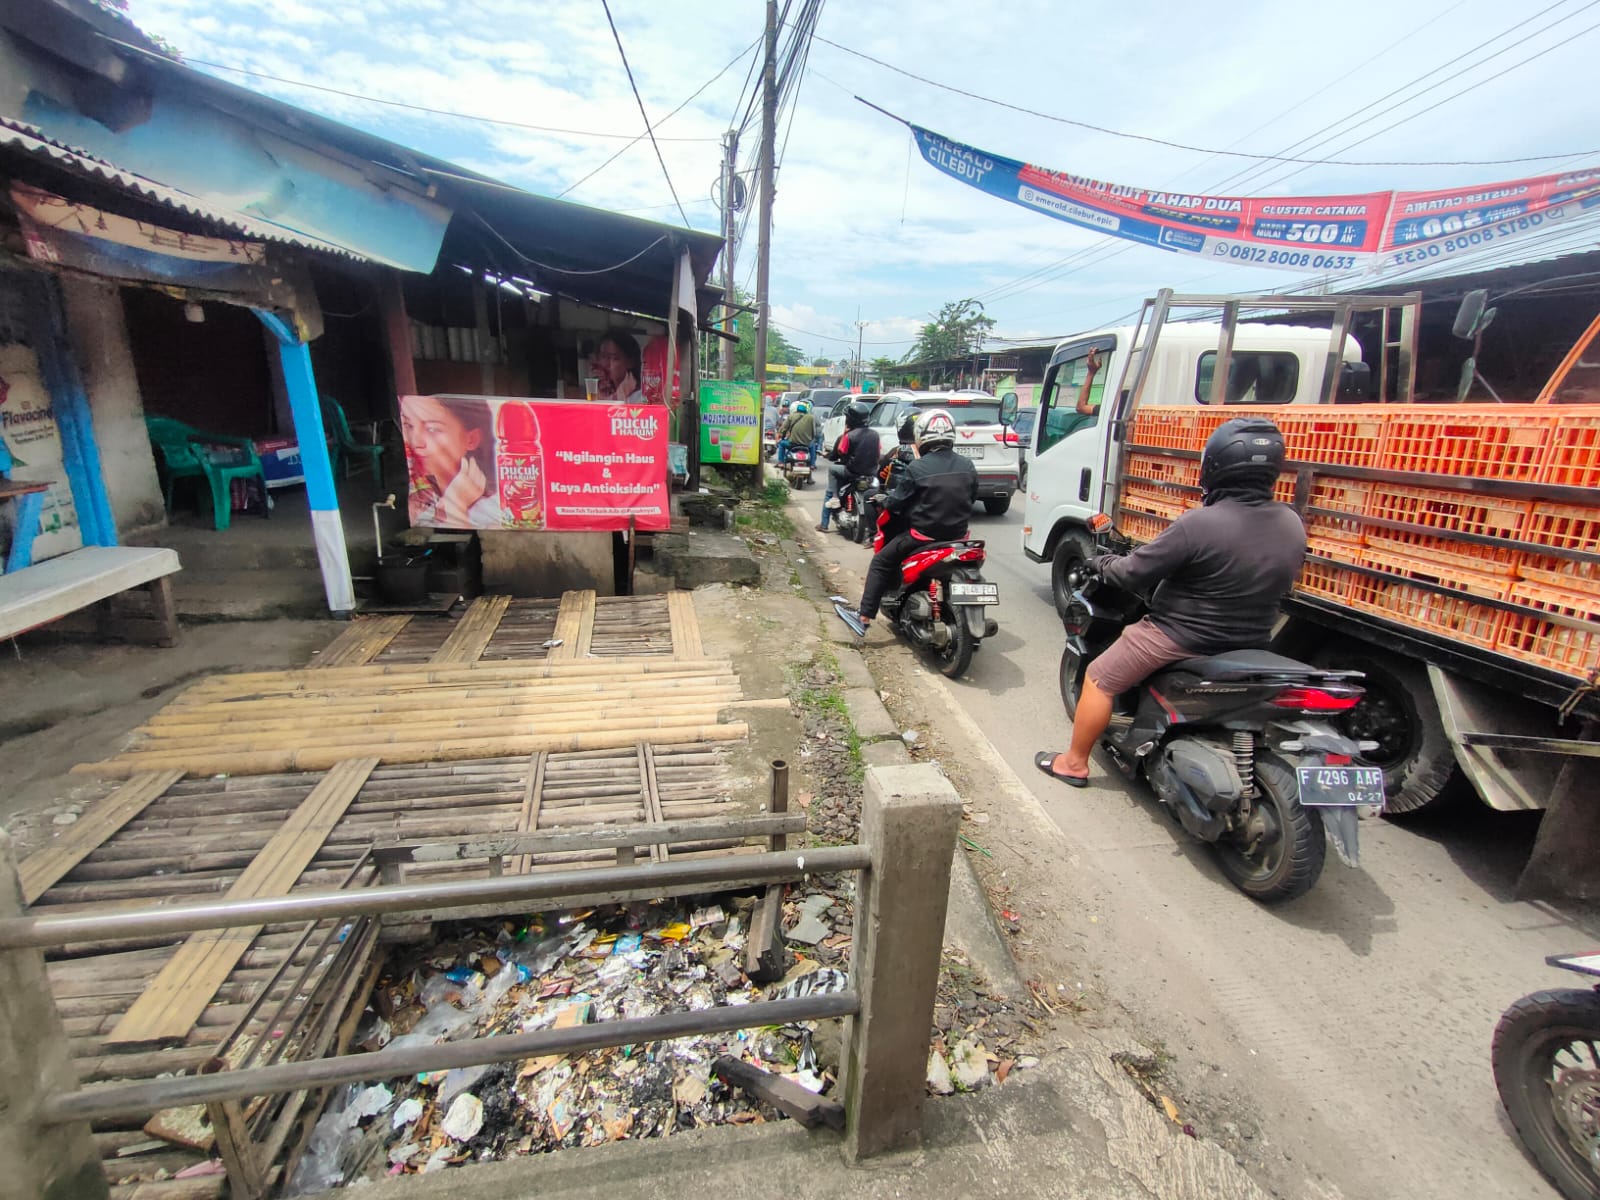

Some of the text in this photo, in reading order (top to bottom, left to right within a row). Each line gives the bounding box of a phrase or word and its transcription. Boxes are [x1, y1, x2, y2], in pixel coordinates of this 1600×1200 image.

[928, 146, 985, 183] CILEBUT
[1035, 194, 1114, 226] emerald.cilebut.epic
[1146, 191, 1203, 209] TAHAP
[1204, 198, 1243, 213] DUA
[1262, 205, 1367, 216] CLUSTER CATANIA
[1256, 229, 1282, 239] MULAI
[1285, 223, 1339, 243] 500
[1229, 244, 1356, 270] 0812 8008 0633
[611, 415, 659, 436] pucuk
[619, 428, 654, 437] HARUM
[625, 452, 655, 464] Haus
[602, 467, 613, 479] &
[550, 481, 581, 495] Kaya
[1300, 770, 1381, 786] F 4296 AAF
